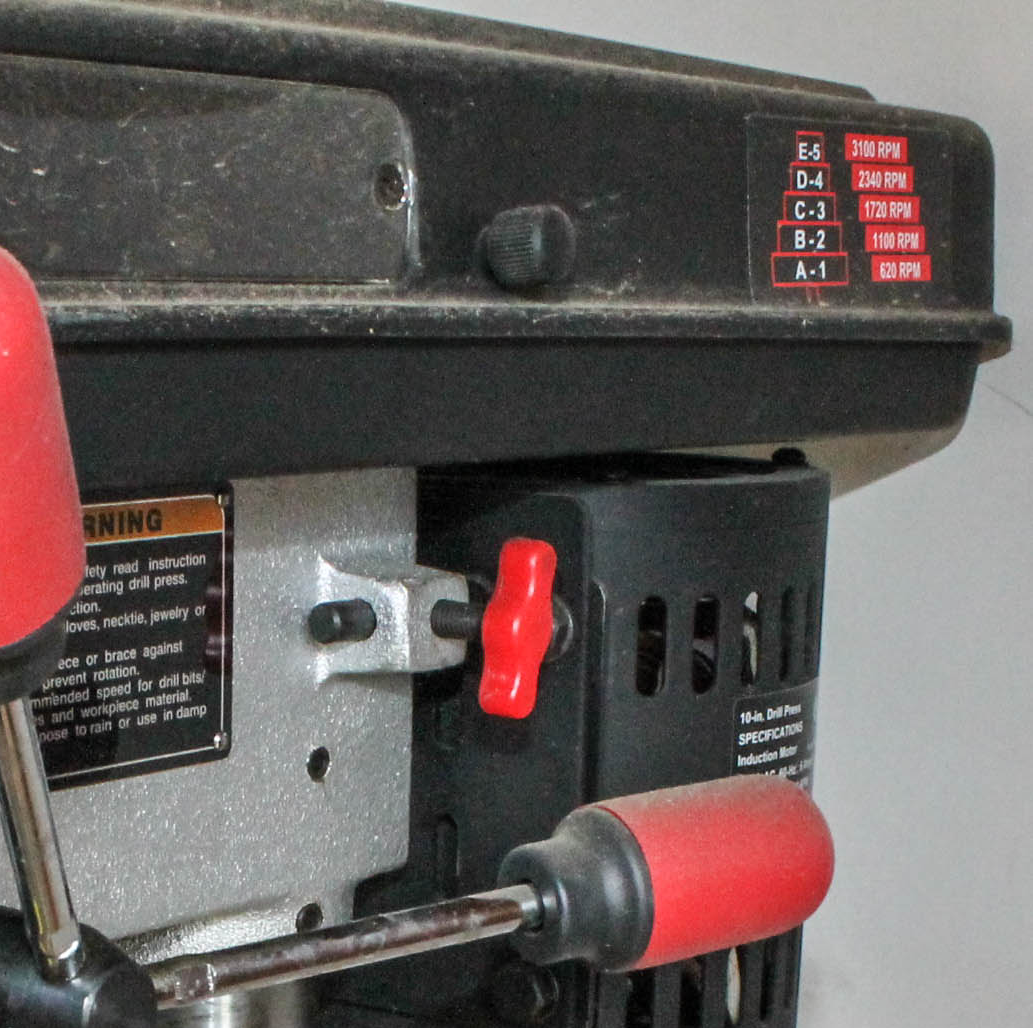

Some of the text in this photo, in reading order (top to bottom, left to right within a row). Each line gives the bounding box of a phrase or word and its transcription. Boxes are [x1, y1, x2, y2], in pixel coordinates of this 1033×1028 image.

[798, 143, 820, 161] E-5
[852, 140, 901, 159] 3100 RPM
[858, 171, 907, 189] 2340 RPM
[865, 201, 912, 219] 1720 RPM
[873, 232, 919, 249] 1100 RPM
[880, 262, 921, 279] 620 RPM
[83, 508, 163, 537] RNING
[85, 553, 206, 579] fety read instruction
[80, 573, 188, 596] erating drill press.
[65, 620, 100, 633] loves,
[150, 605, 189, 626] jewelry
[195, 605, 206, 617] or
[86, 653, 98, 667] or
[105, 648, 137, 664] brace
[143, 640, 183, 660] against
[93, 664, 140, 682] rotation.
[30, 687, 90, 709] mmended
[96, 681, 132, 701] speed
[138, 678, 153, 692] for
[159, 673, 180, 689] drill
[52, 707, 74, 724] and
[80, 699, 139, 717] workpiece
[146, 688, 192, 708] material.
[75, 725, 87, 737] to
[90, 720, 112, 734] rain
[118, 718, 131, 729] or
[137, 712, 157, 726] use
[163, 709, 173, 721] in
[176, 705, 207, 719] damp
[738, 721, 804, 746] SPECIFICATIONS
[737, 750, 778, 767] Induction
